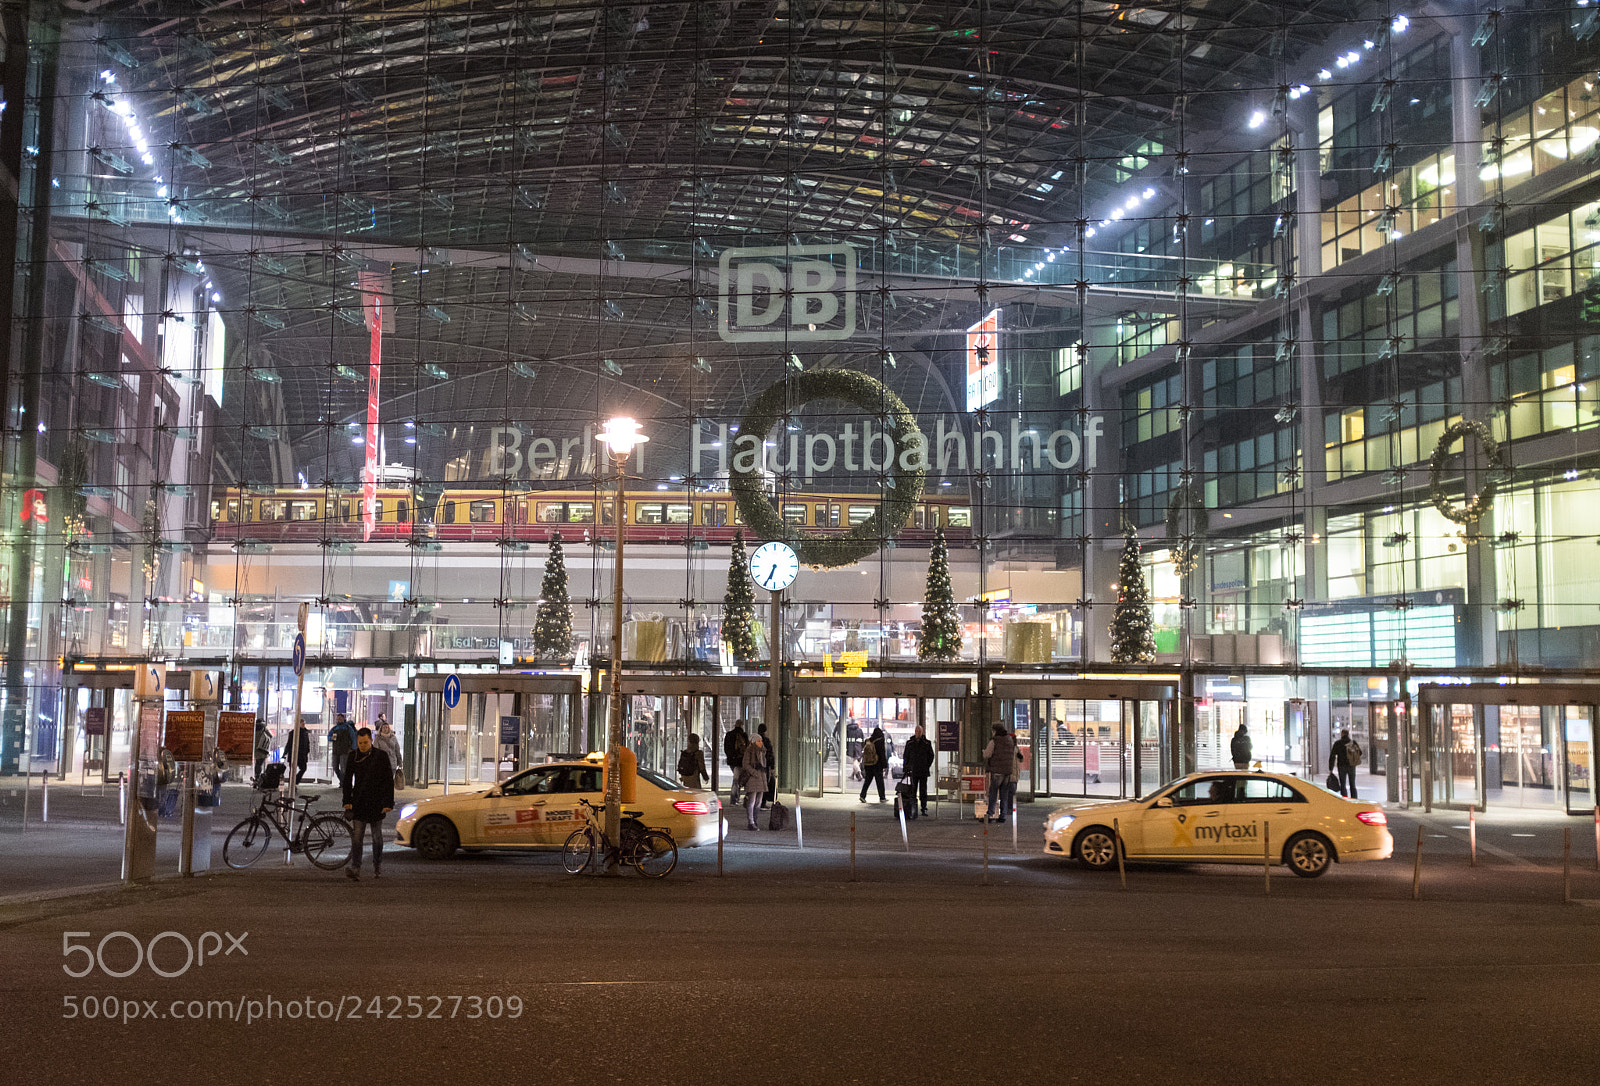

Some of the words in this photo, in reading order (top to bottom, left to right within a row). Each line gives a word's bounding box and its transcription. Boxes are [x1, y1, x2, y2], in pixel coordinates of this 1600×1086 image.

[737, 261, 839, 327] DB
[691, 416, 1104, 484] Hauptbahnhof
[1195, 820, 1257, 843] mytaxi
